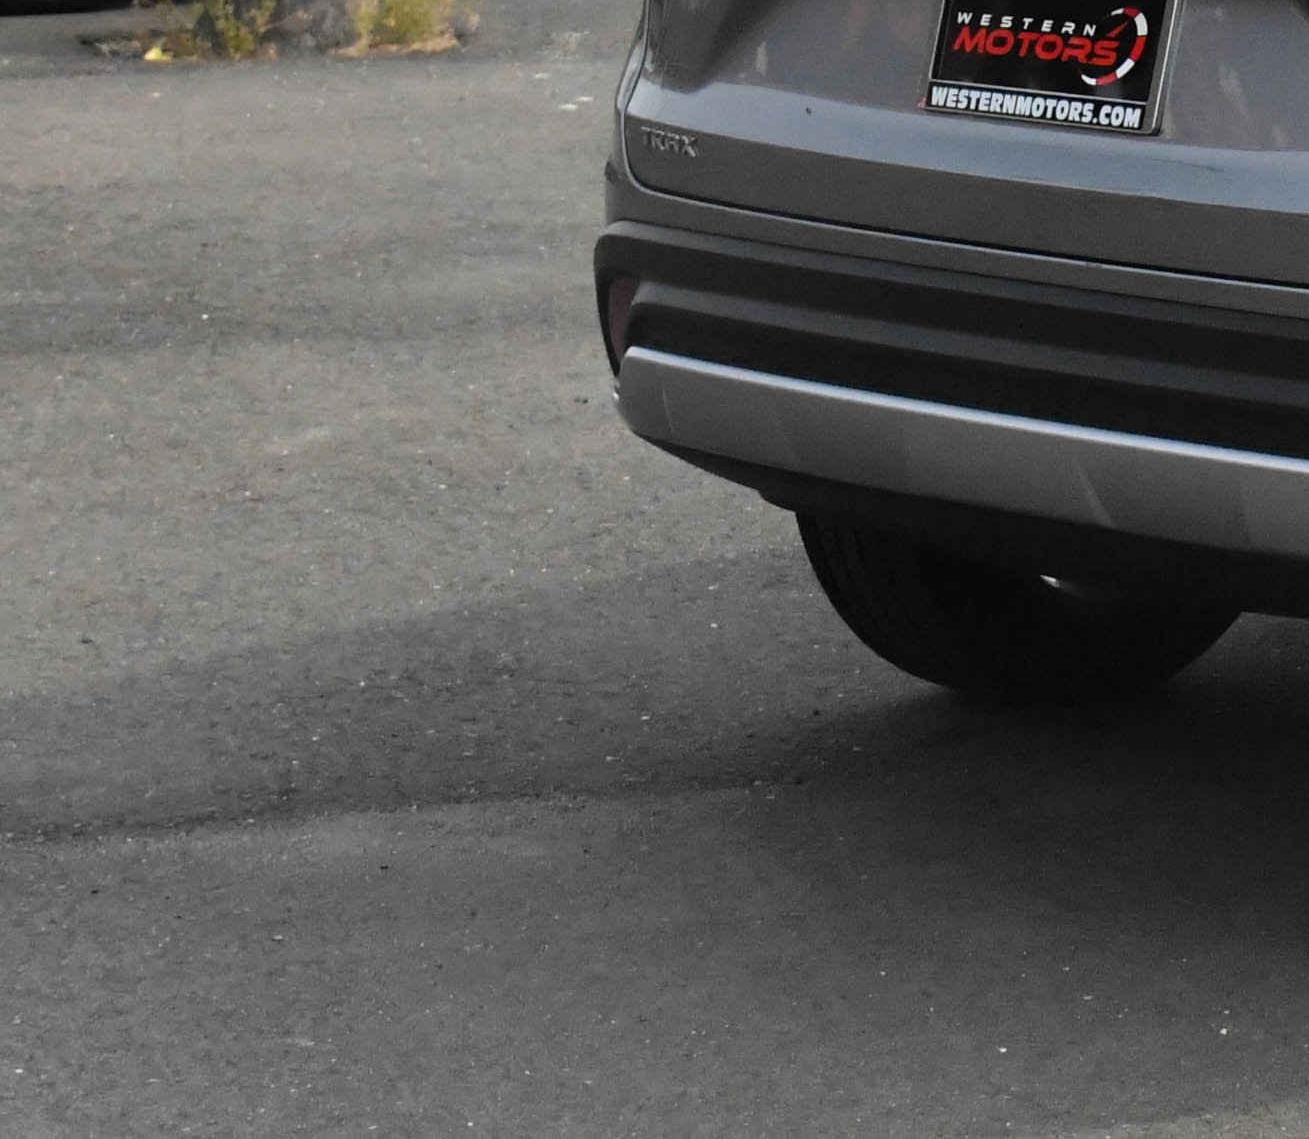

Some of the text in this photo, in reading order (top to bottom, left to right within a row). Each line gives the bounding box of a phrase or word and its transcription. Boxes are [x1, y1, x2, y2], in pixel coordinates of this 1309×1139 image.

[956, 11, 1097, 37] WESTERN
[952, 25, 1121, 67] MOTORS
[931, 85, 1142, 128] WESTERNMOTORS.COM
[640, 126, 698, 158] TRAX
